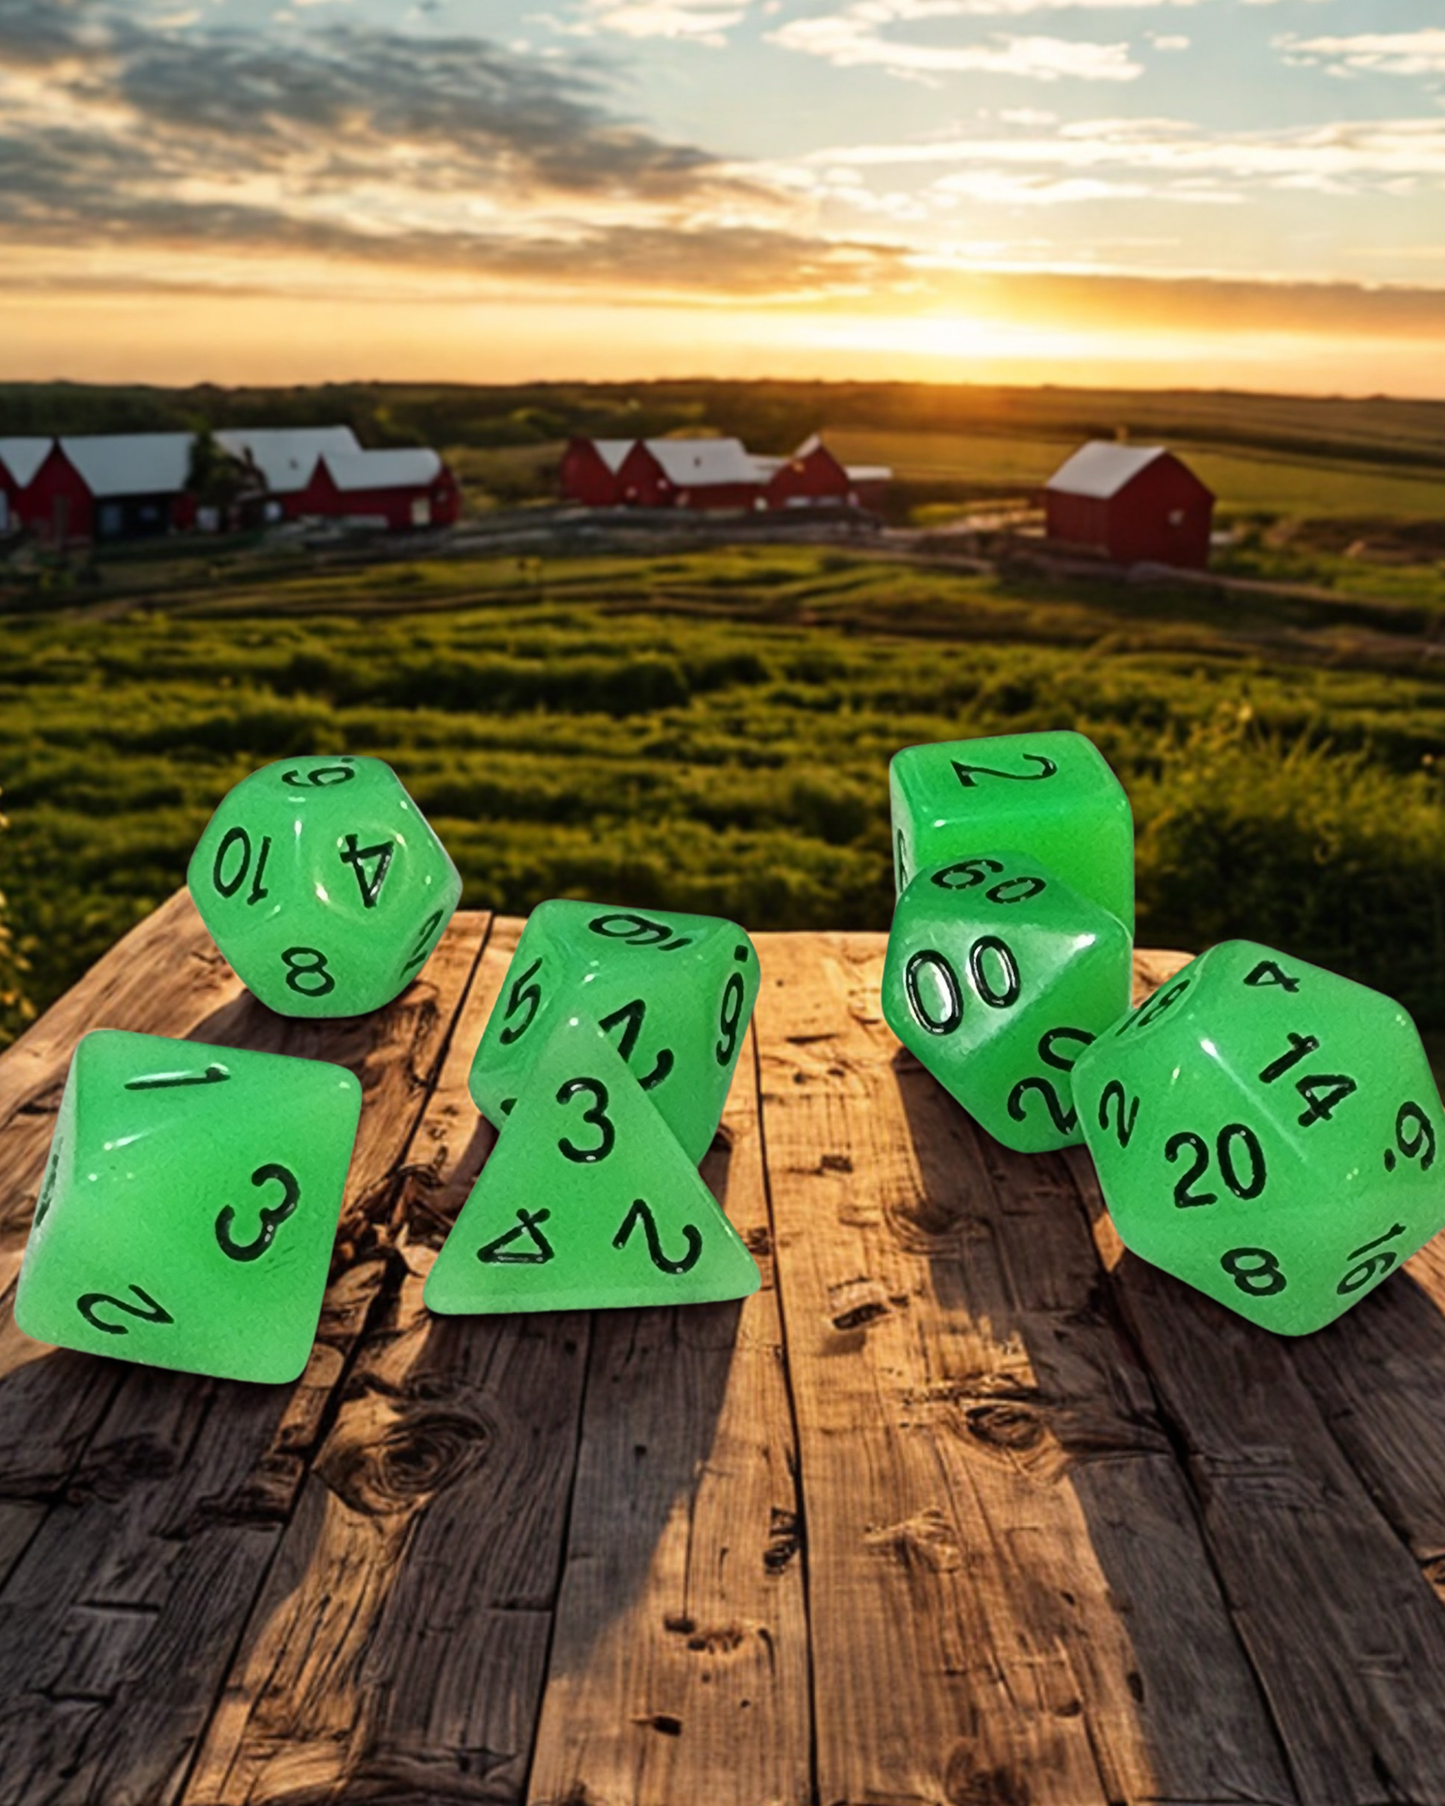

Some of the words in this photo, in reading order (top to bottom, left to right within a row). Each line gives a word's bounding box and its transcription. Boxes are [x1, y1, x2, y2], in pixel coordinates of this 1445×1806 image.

[950, 753, 1058, 788] 2
[213, 826, 271, 906] 10
[340, 833, 394, 909] 4
[281, 946, 336, 997] 8
[499, 957, 543, 1046] 5
[904, 935, 1021, 1037] 00
[1243, 960, 1301, 993] 4
[1098, 1079, 1141, 1149] 2
[1258, 1031, 1358, 1128] 14
[556, 1077, 616, 1164] 3
[1164, 1122, 1268, 1209] 20
[214, 1162, 301, 1263] 3
[476, 1207, 556, 1265] 4
[612, 1198, 703, 1276] 2
[1220, 1246, 1288, 1298] 8
[1336, 1222, 1407, 1296] 16
[76, 1284, 175, 1335] 2
